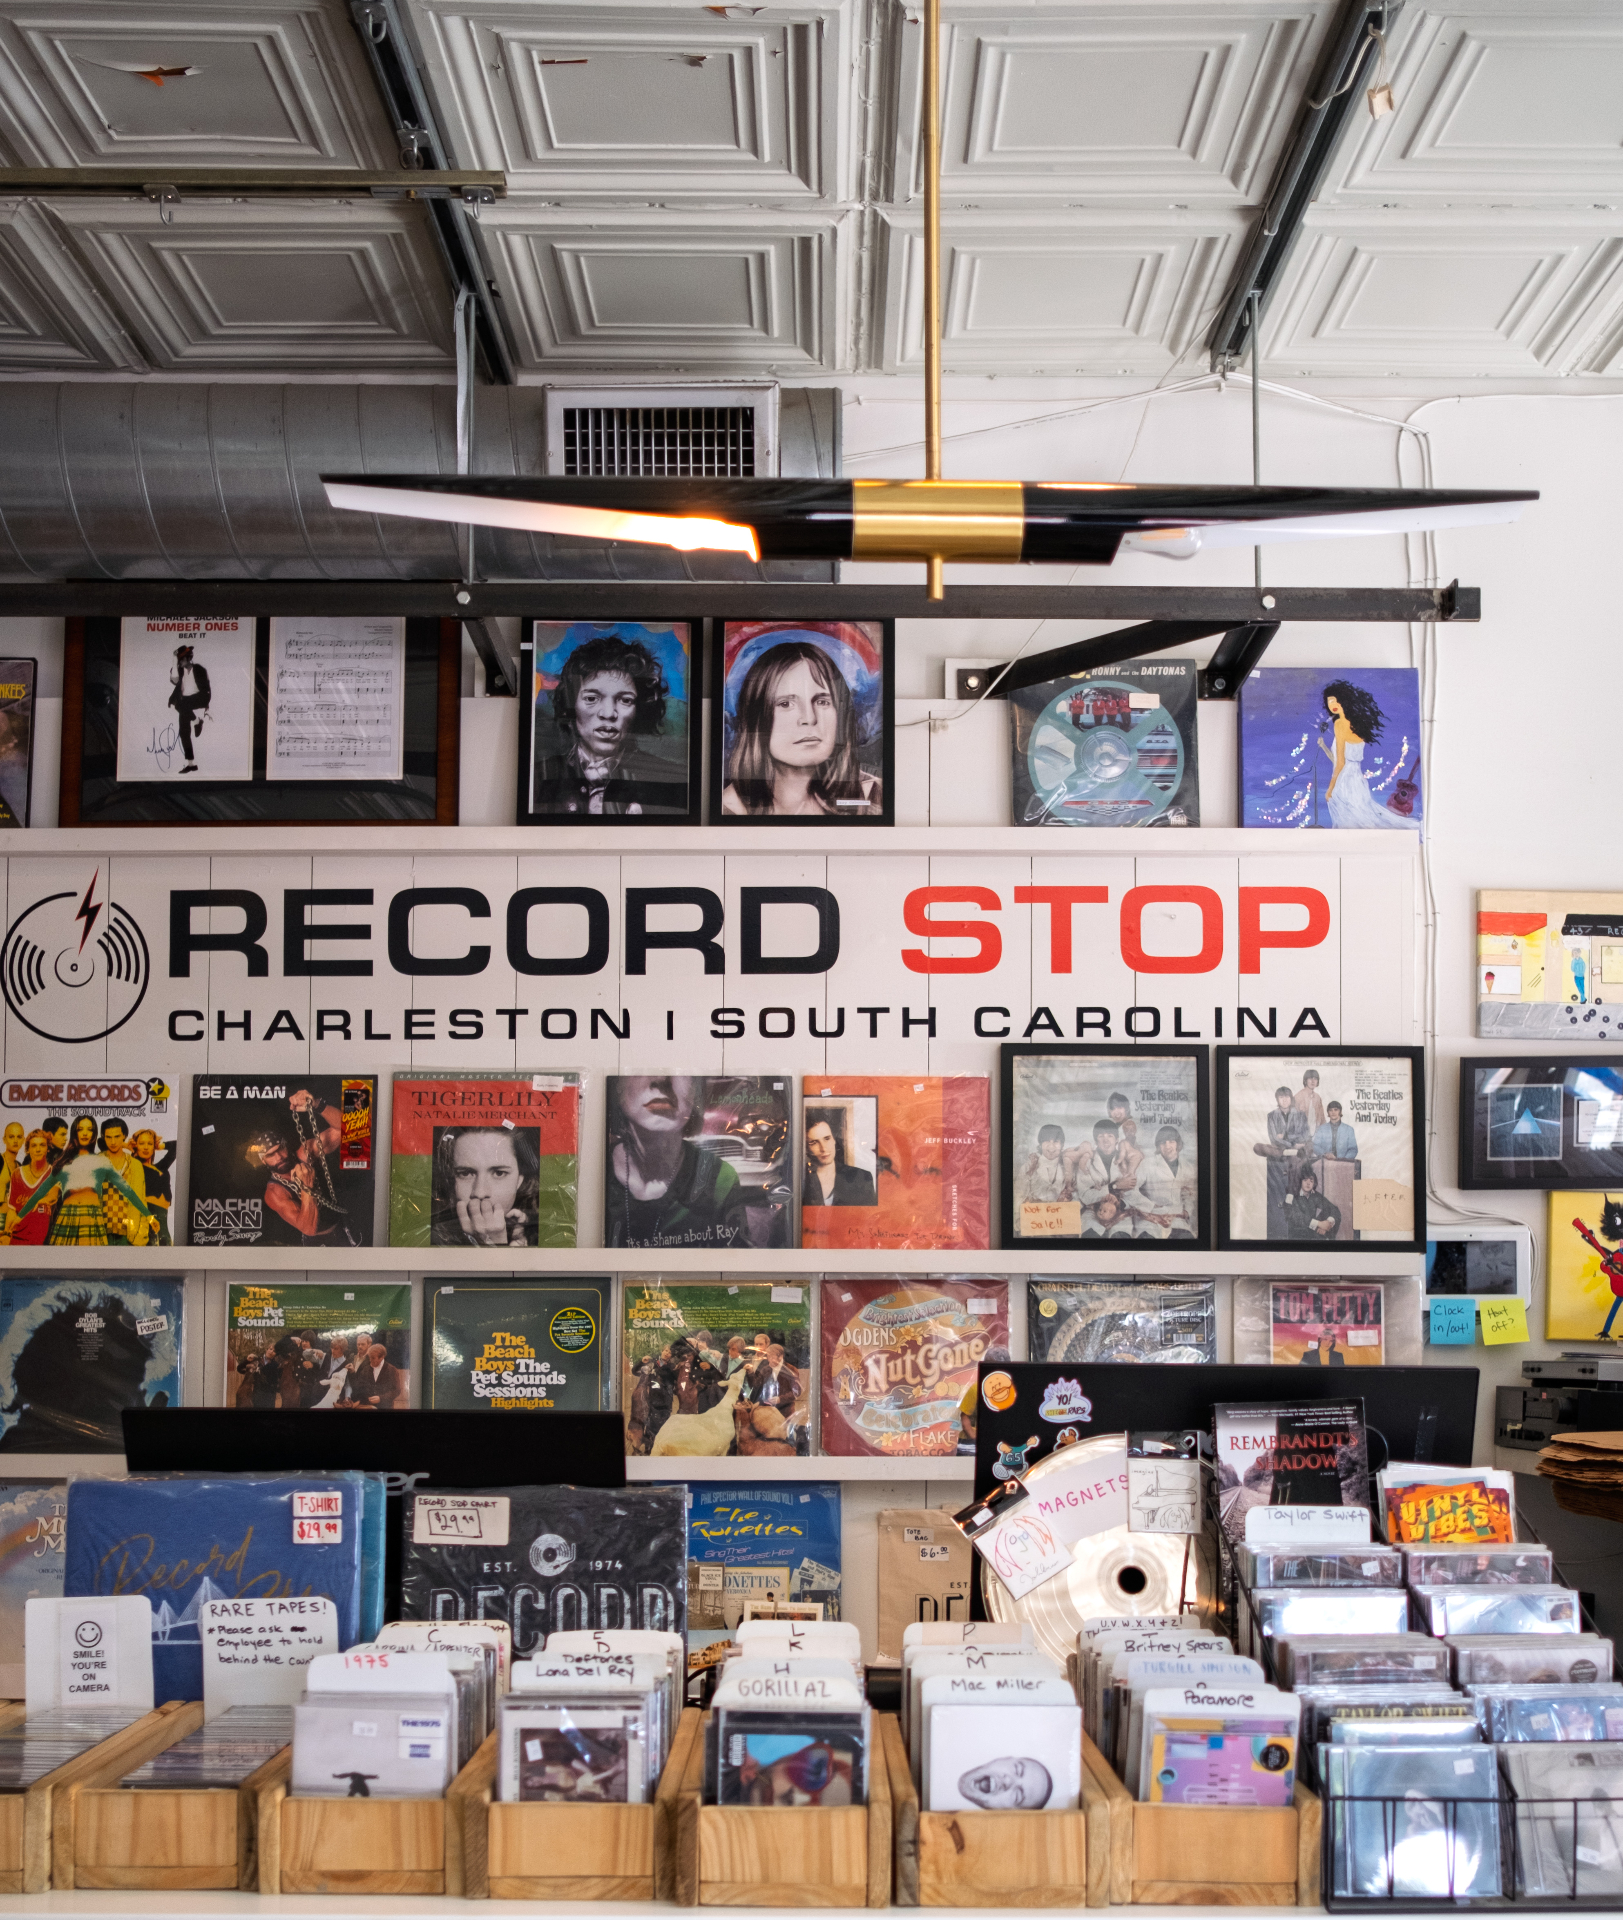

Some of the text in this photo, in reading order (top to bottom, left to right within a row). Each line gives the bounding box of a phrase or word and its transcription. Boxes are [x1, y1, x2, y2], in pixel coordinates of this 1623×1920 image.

[146, 622, 239, 632] NUMBER ONES
[1091, 666, 1121, 676] RONNY
[1141, 666, 1186, 676] DAYTONAS
[169, 885, 1331, 977] RECORD STOP
[168, 1006, 1332, 1042] CHARLESTON SOUTH CAROLINA
[8, 1084, 142, 1102] EMPIRE RECORDS
[199, 1085, 286, 1099] BE A MAN
[1140, 1089, 1189, 1101] The Beatles
[1355, 1089, 1404, 1101] The Beatles
[412, 1091, 558, 1107] TIGERLILY
[47, 1107, 147, 1117] THE SOUNDTRACK
[1135, 1101, 1176, 1113] Yesterday
[1350, 1101, 1391, 1113] Yesterday
[413, 1110, 558, 1120] NATALIE MERCHANT
[1139, 1113, 1183, 1126] And Today
[1355, 1112, 1398, 1126] And Today
[194, 1198, 262, 1211] MACHO
[1024, 1205, 1041, 1214] Not
[193, 1210, 262, 1229] MAN
[653, 1225, 739, 1246] shame about Ray
[247, 1288, 272, 1299] The
[642, 1289, 670, 1299] The
[240, 1297, 278, 1308] Beach
[635, 1299, 677, 1309] Beach
[1277, 1292, 1376, 1321] TOM PETTY
[233, 1307, 262, 1319] Boys
[263, 1307, 285, 1317] Pet
[628, 1309, 660, 1320] Boys
[661, 1308, 682, 1319] Pet
[1433, 1304, 1465, 1316] Clock
[139, 1321, 165, 1334] POSTER
[237, 1316, 285, 1327] Sounds
[632, 1317, 684, 1329] Sounds
[1491, 1318, 1516, 1333] off?
[491, 1332, 526, 1346] The
[483, 1344, 536, 1358] Beach
[474, 1357, 551, 1373] Boys The
[470, 1370, 567, 1385] Pet Sounds
[473, 1384, 547, 1398] Sessions
[490, 1398, 554, 1410] Highlights
[1056, 1393, 1072, 1406] YO!
[1229, 1432, 1359, 1450] REMBRANDT'S
[1256, 1453, 1338, 1471] SHADOW
[418, 1497, 447, 1508] RECORD
[712, 1490, 737, 1502] SPECTOR
[737, 1490, 754, 1501] WALL
[755, 1490, 762, 1501] OF
[762, 1490, 781, 1502] SOUND
[1038, 1474, 1129, 1518] MAGNETS
[297, 1496, 339, 1513] T-SHIRT
[1399, 1488, 1489, 1525] VINYL
[713, 1506, 759, 1523] The
[1264, 1507, 1369, 1525] Taylor Swift
[1409, 1503, 1490, 1541] VIBES
[297, 1521, 338, 1540] $29.99
[691, 1521, 803, 1538] Ronettes
[704, 1549, 726, 1559] Sing
[725, 1551, 771, 1564] Greatest
[483, 1560, 623, 1573] EST. 1974
[724, 1576, 781, 1589] ONETTES
[950, 1581, 971, 1589] EST.
[210, 1601, 327, 1617] RARE TAPES!
[217, 1625, 284, 1635] Please ask
[428, 1629, 442, 1643] C
[792, 1623, 805, 1636] L
[963, 1622, 976, 1641] P
[216, 1636, 323, 1652] employee to hold
[789, 1639, 803, 1652] K
[1124, 1640, 1181, 1654] Britney
[73, 1650, 105, 1659] SMILE!
[218, 1655, 284, 1665] behind the
[562, 1654, 634, 1665] Deftones
[71, 1661, 107, 1670] YOU'RE
[344, 1654, 389, 1669] 1975
[966, 1656, 986, 1669] M
[82, 1673, 96, 1682] ON
[536, 1665, 635, 1685] Lana Del Rey
[69, 1684, 110, 1693] CAMERA
[738, 1678, 832, 1698] GORILLAZ
[951, 1679, 1046, 1692] Mac Miller
[1184, 1690, 1255, 1708] Paramore
